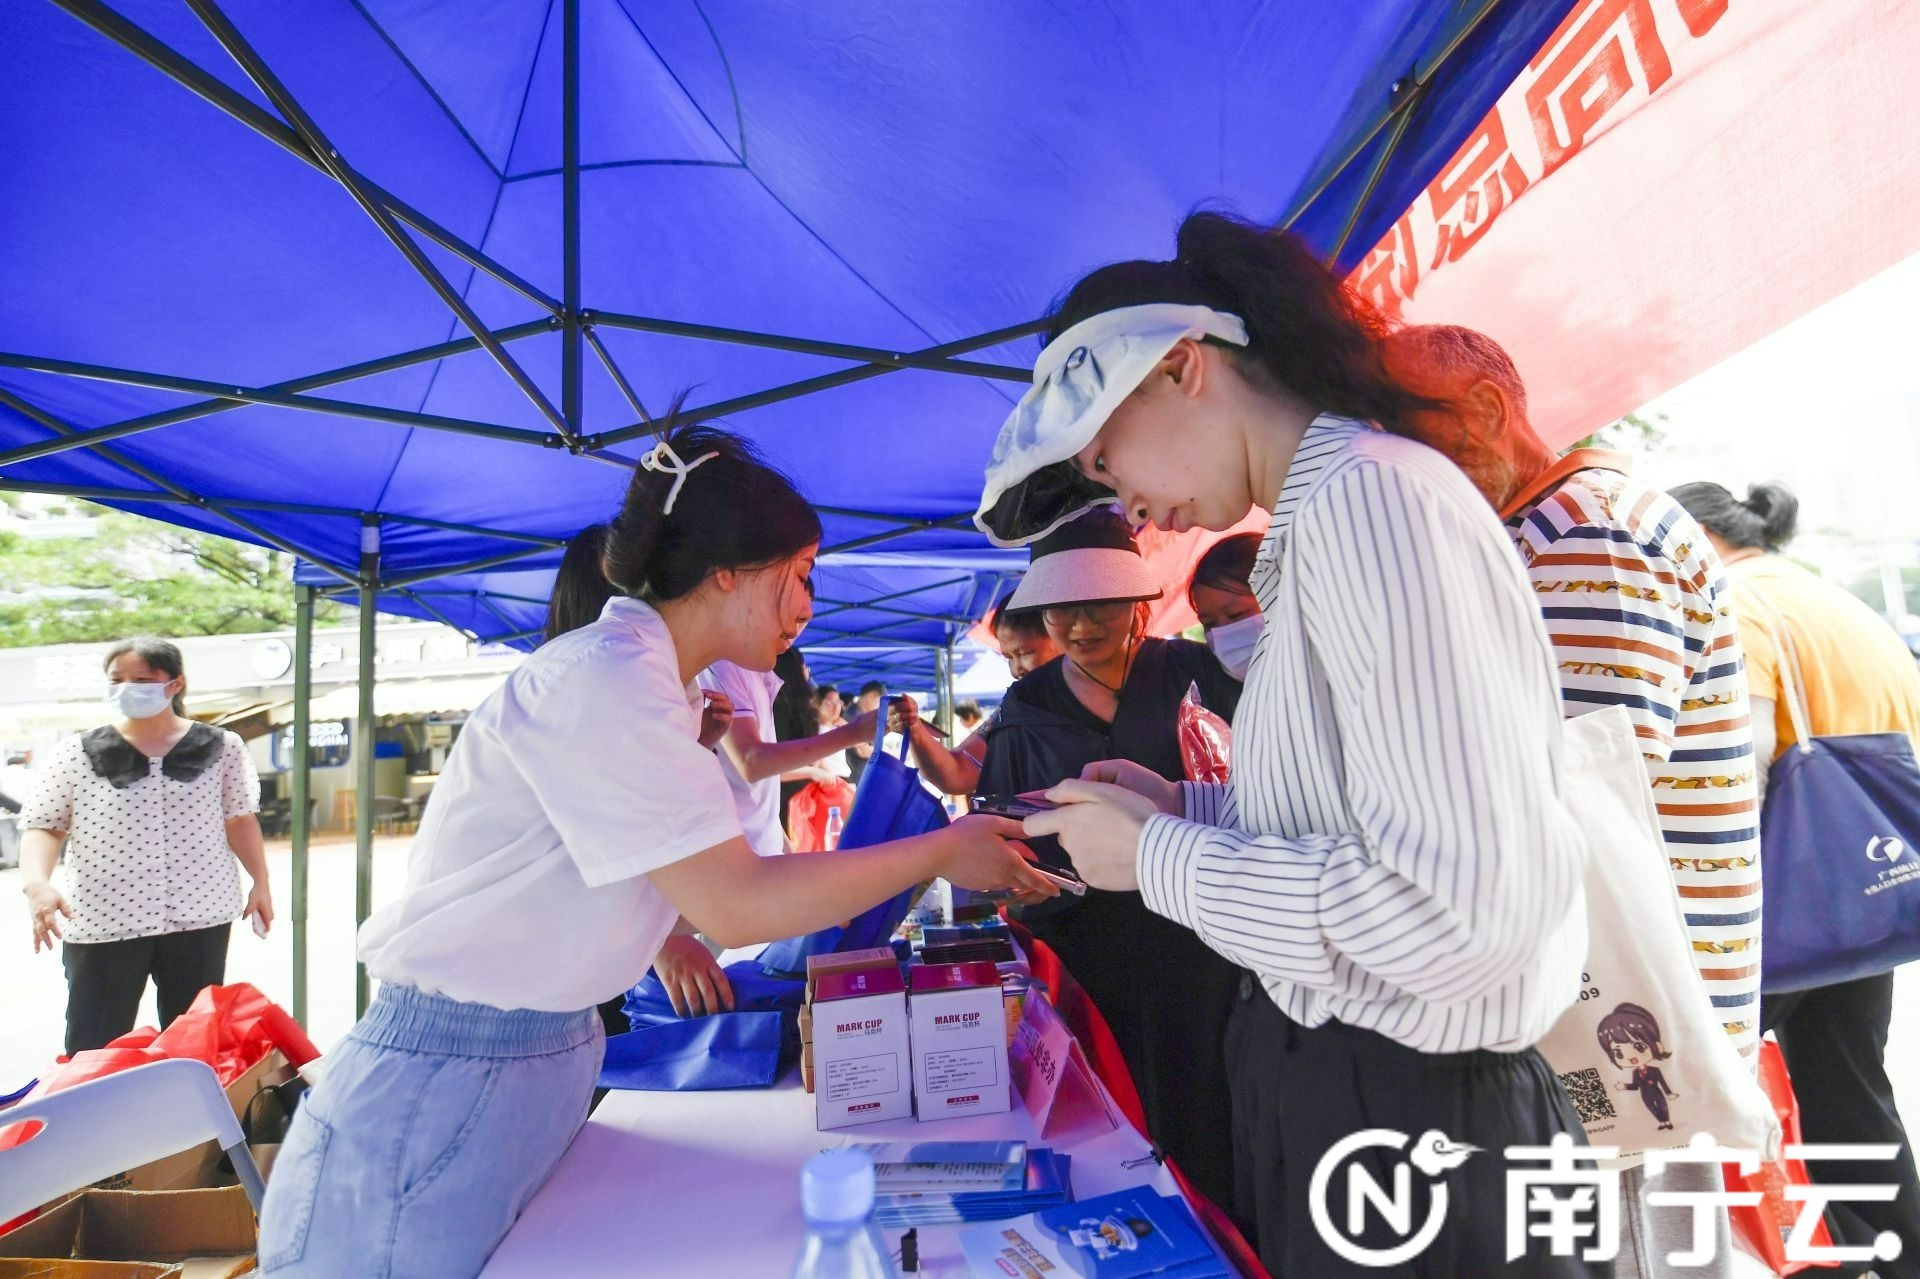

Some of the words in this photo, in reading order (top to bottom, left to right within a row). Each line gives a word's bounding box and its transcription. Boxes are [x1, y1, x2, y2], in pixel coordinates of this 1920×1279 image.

[281, 734, 349, 749] SNGHAI
[1576, 987, 1600, 1003] 09
[934, 1013, 961, 1025] MARK
[962, 1012, 980, 1022] CUP
[836, 1021, 863, 1033] MARK
[865, 1019, 883, 1029] CUP
